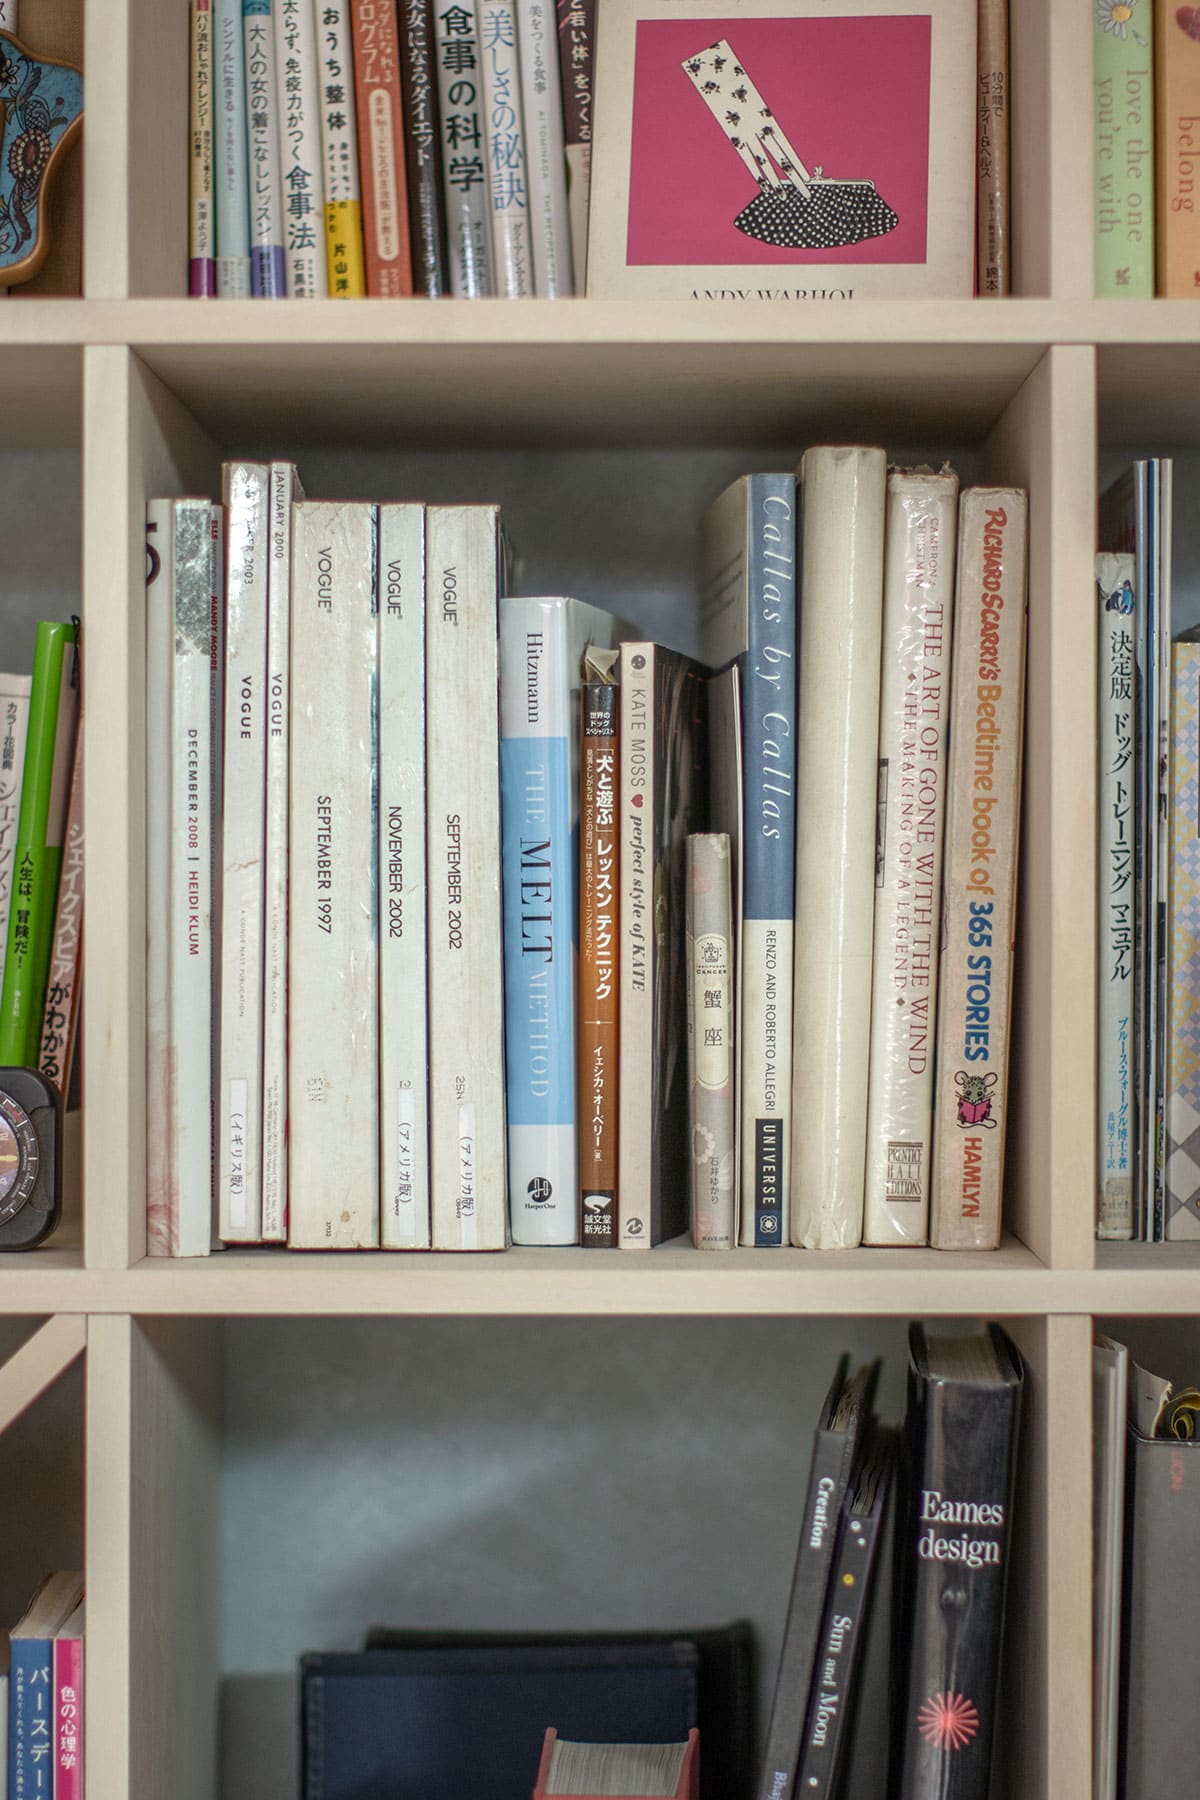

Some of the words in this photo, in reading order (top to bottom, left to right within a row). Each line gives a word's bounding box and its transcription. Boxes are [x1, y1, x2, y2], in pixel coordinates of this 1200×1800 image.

[322, 7, 348, 131] おうち整体
[359, 0, 380, 83] ログラム
[439, 5, 484, 192] 食事の科学
[483, 9, 525, 210] 美しさの秘訣
[1126, 69, 1148, 125] love
[1127, 139, 1149, 179] the
[1171, 116, 1200, 213] belong
[1099, 173, 1121, 234] with
[1127, 192, 1142, 242] one
[273, 470, 284, 527] JANUARY
[243, 555, 254, 585] 2003
[274, 531, 284, 559] 2000
[762, 496, 792, 624] Callas
[981, 506, 1008, 592] RICHARD
[318, 547, 332, 609] VOGUE
[387, 560, 401, 616] VOGUE
[443, 566, 458, 623] VOGUE
[210, 596, 218, 632] MANDY
[923, 603, 944, 658] THE
[978, 592, 1004, 682] SCARRY'S
[210, 634, 218, 671] MOORE
[526, 631, 543, 724] Hitzmann
[755, 645, 791, 690] by
[1109, 630, 1132, 700] 決定版
[240, 676, 252, 739] VOGUE
[271, 673, 283, 737] VOGUE
[631, 688, 646, 730] KATE
[921, 666, 942, 720] ART
[631, 739, 646, 788] MOSS
[919, 727, 939, 762] OF
[973, 685, 1001, 791] Bedtime
[1111, 713, 1132, 774] ドッグ
[188, 729, 198, 811] DECEMBER
[525, 765, 545, 824] THE
[762, 711, 791, 840] Callas
[899, 742, 916, 832] MAKING
[188, 816, 199, 849] 2008
[916, 767, 938, 844] GONE
[970, 798, 999, 864] book
[317, 795, 332, 890] SEPTEMBER
[388, 806, 402, 893] NOVEMBER
[447, 814, 462, 905] SEPTEMBER
[629, 814, 646, 874] perfect
[899, 841, 913, 869] OF
[1110, 781, 1132, 894] トレーニング
[188, 870, 199, 910] HEIDI
[520, 837, 553, 963] MELT
[629, 878, 646, 918] style
[898, 879, 911, 890] A
[913, 852, 935, 926] WITH
[966, 867, 995, 896] of
[188, 914, 199, 955] KLUM
[317, 897, 332, 934] 1997
[389, 899, 402, 938] 2002
[448, 910, 463, 950] 2002
[629, 922, 646, 941] of
[968, 901, 994, 948] 365
[1110, 903, 1132, 981] マニュアル
[631, 945, 646, 992] KATE
[765, 929, 777, 970] RENZO
[893, 902, 910, 989] LEGEND
[911, 934, 932, 987] THE
[766, 973, 777, 1000] AND
[964, 955, 992, 1062] STORIES
[528, 971, 550, 1097] METHOD
[703, 988, 723, 1047] 蟹座
[764, 1003, 777, 1059] ROBERTO
[907, 995, 929, 1075] WIND
[763, 1062, 776, 1112] ALLEGRI
[397, 1122, 412, 1203] (アメリカ版)
[459, 1136, 474, 1217] (アメリカ版)
[762, 1124, 777, 1205] UNIVERSE
[961, 1137, 983, 1218] HAMLYN
[809, 1476, 834, 1549] Creation
[919, 1489, 1004, 1526] Eames
[918, 1529, 1001, 1568] design
[828, 1614, 852, 1653] Sun
[823, 1657, 837, 1687] and
[30, 1666, 50, 1800] バースデー
[60, 1686, 77, 1770] 色の心理学
[812, 1692, 839, 1746] Moon
